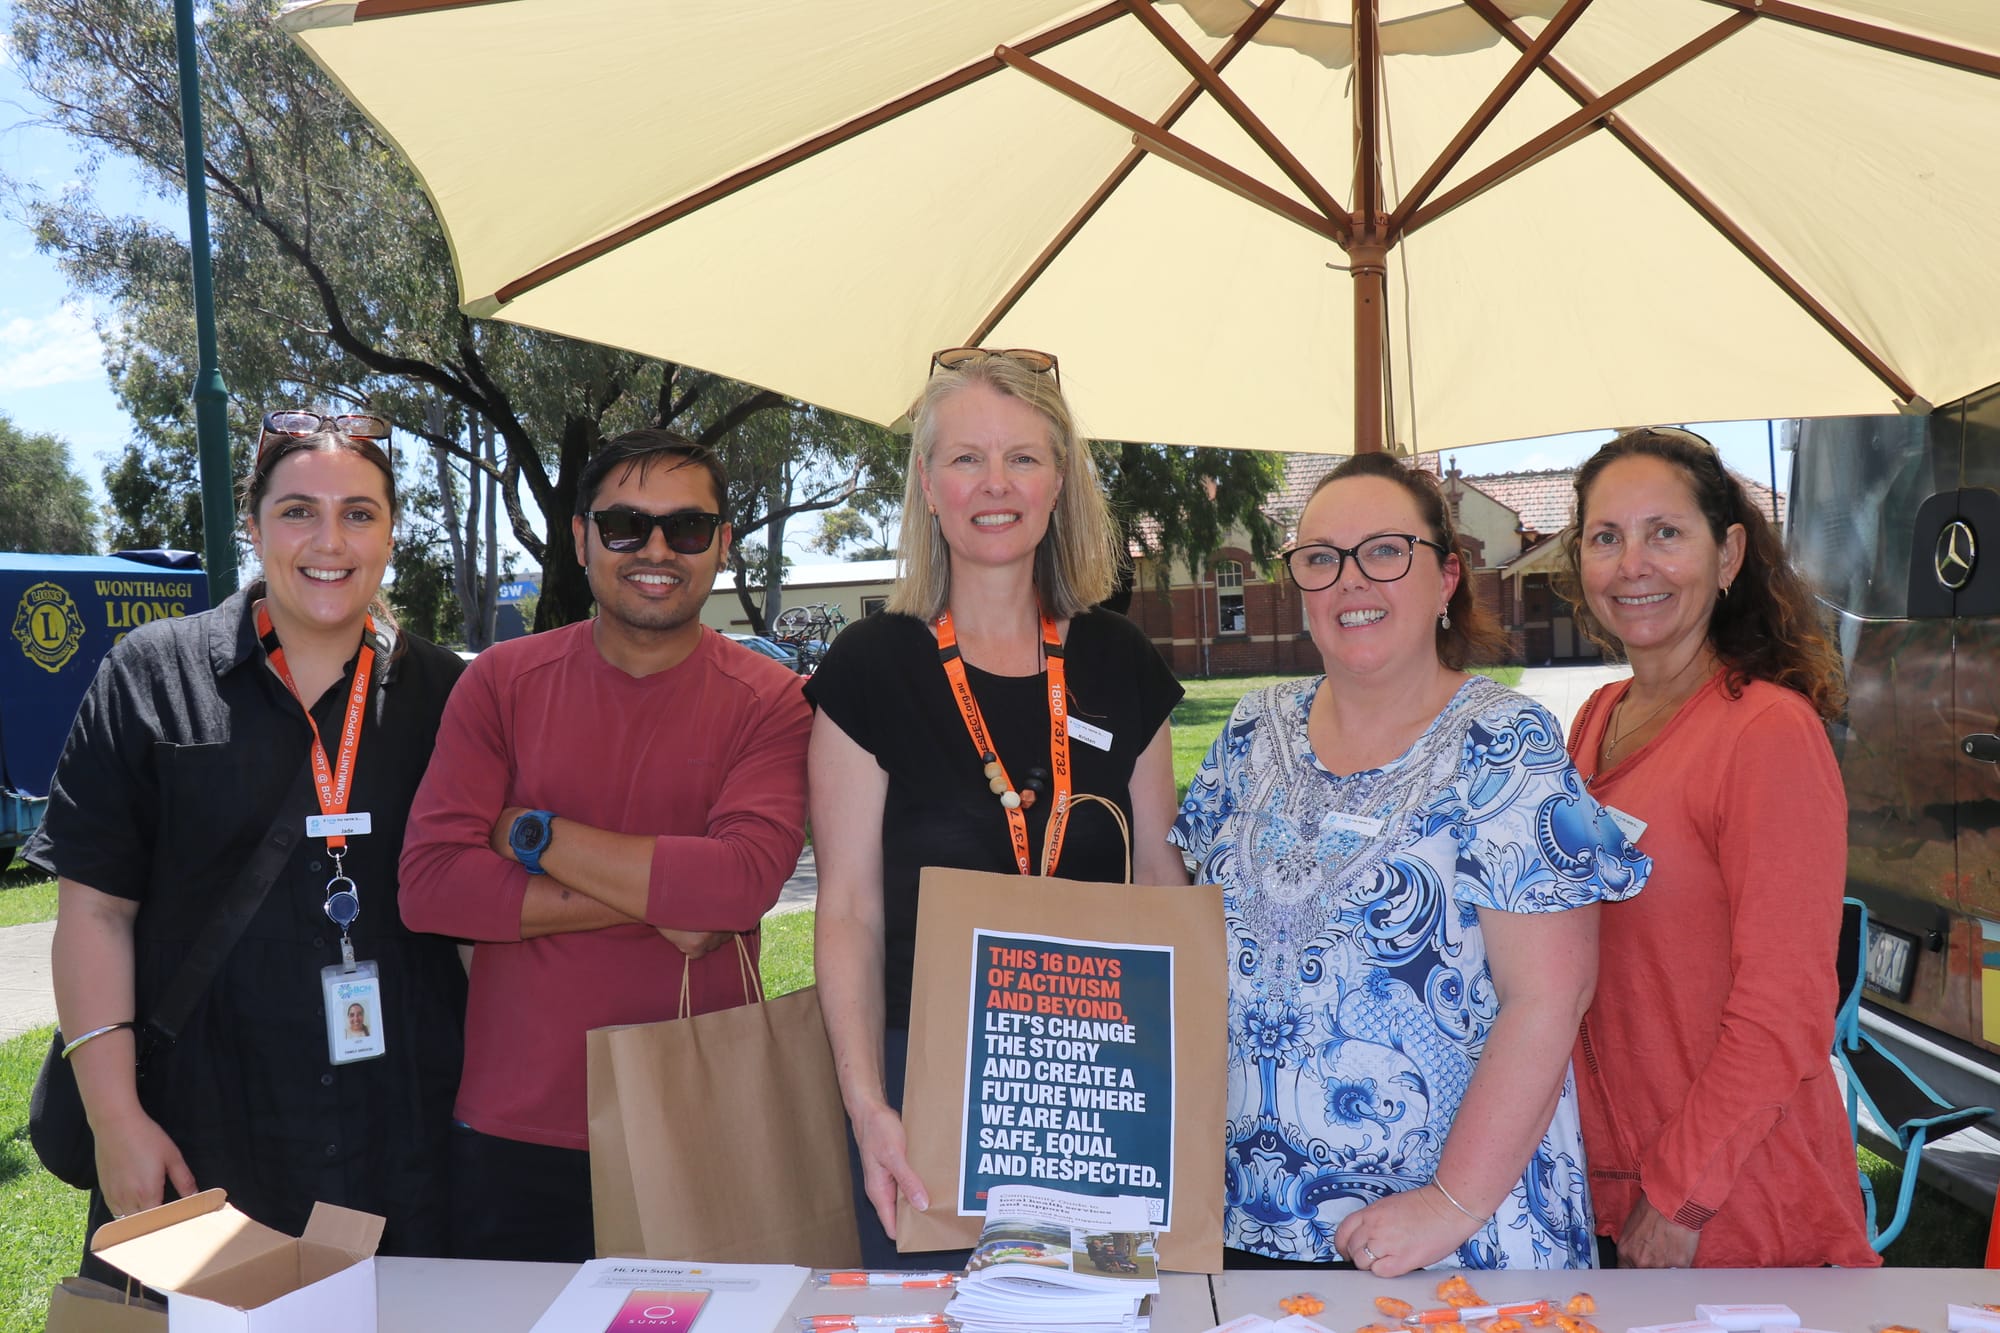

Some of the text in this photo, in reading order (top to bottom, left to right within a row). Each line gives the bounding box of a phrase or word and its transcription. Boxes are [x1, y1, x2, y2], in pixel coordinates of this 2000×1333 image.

[32, 590, 63, 601] LIONS
[95, 581, 192, 598] WONTHAGGI
[40, 612, 60, 641] L
[105, 602, 186, 627] LIONS
[957, 682, 989, 753] ESPECT.org.au
[1051, 683, 1067, 776] 1800 737 732
[334, 748, 353, 805] COMMUNITY
[345, 703, 360, 747] SUPPORT
[355, 673, 365, 693] BCH
[988, 946, 1122, 978] THIS 16 DAYS
[988, 968, 1121, 999] OF ACTIVISM
[986, 990, 1129, 1024] AND BEYOND,
[985, 1012, 1136, 1044] LET’S CHANGE
[984, 1034, 1101, 1063] THE STORY
[982, 1058, 1136, 1089] AND CREATE A
[982, 1080, 1146, 1113] FUTURE WHERE
[981, 1104, 1105, 1134] WE ARE ALL
[979, 1128, 1117, 1160] SAFE, EQUAL
[977, 1153, 1162, 1189] AND RESPECTED.
